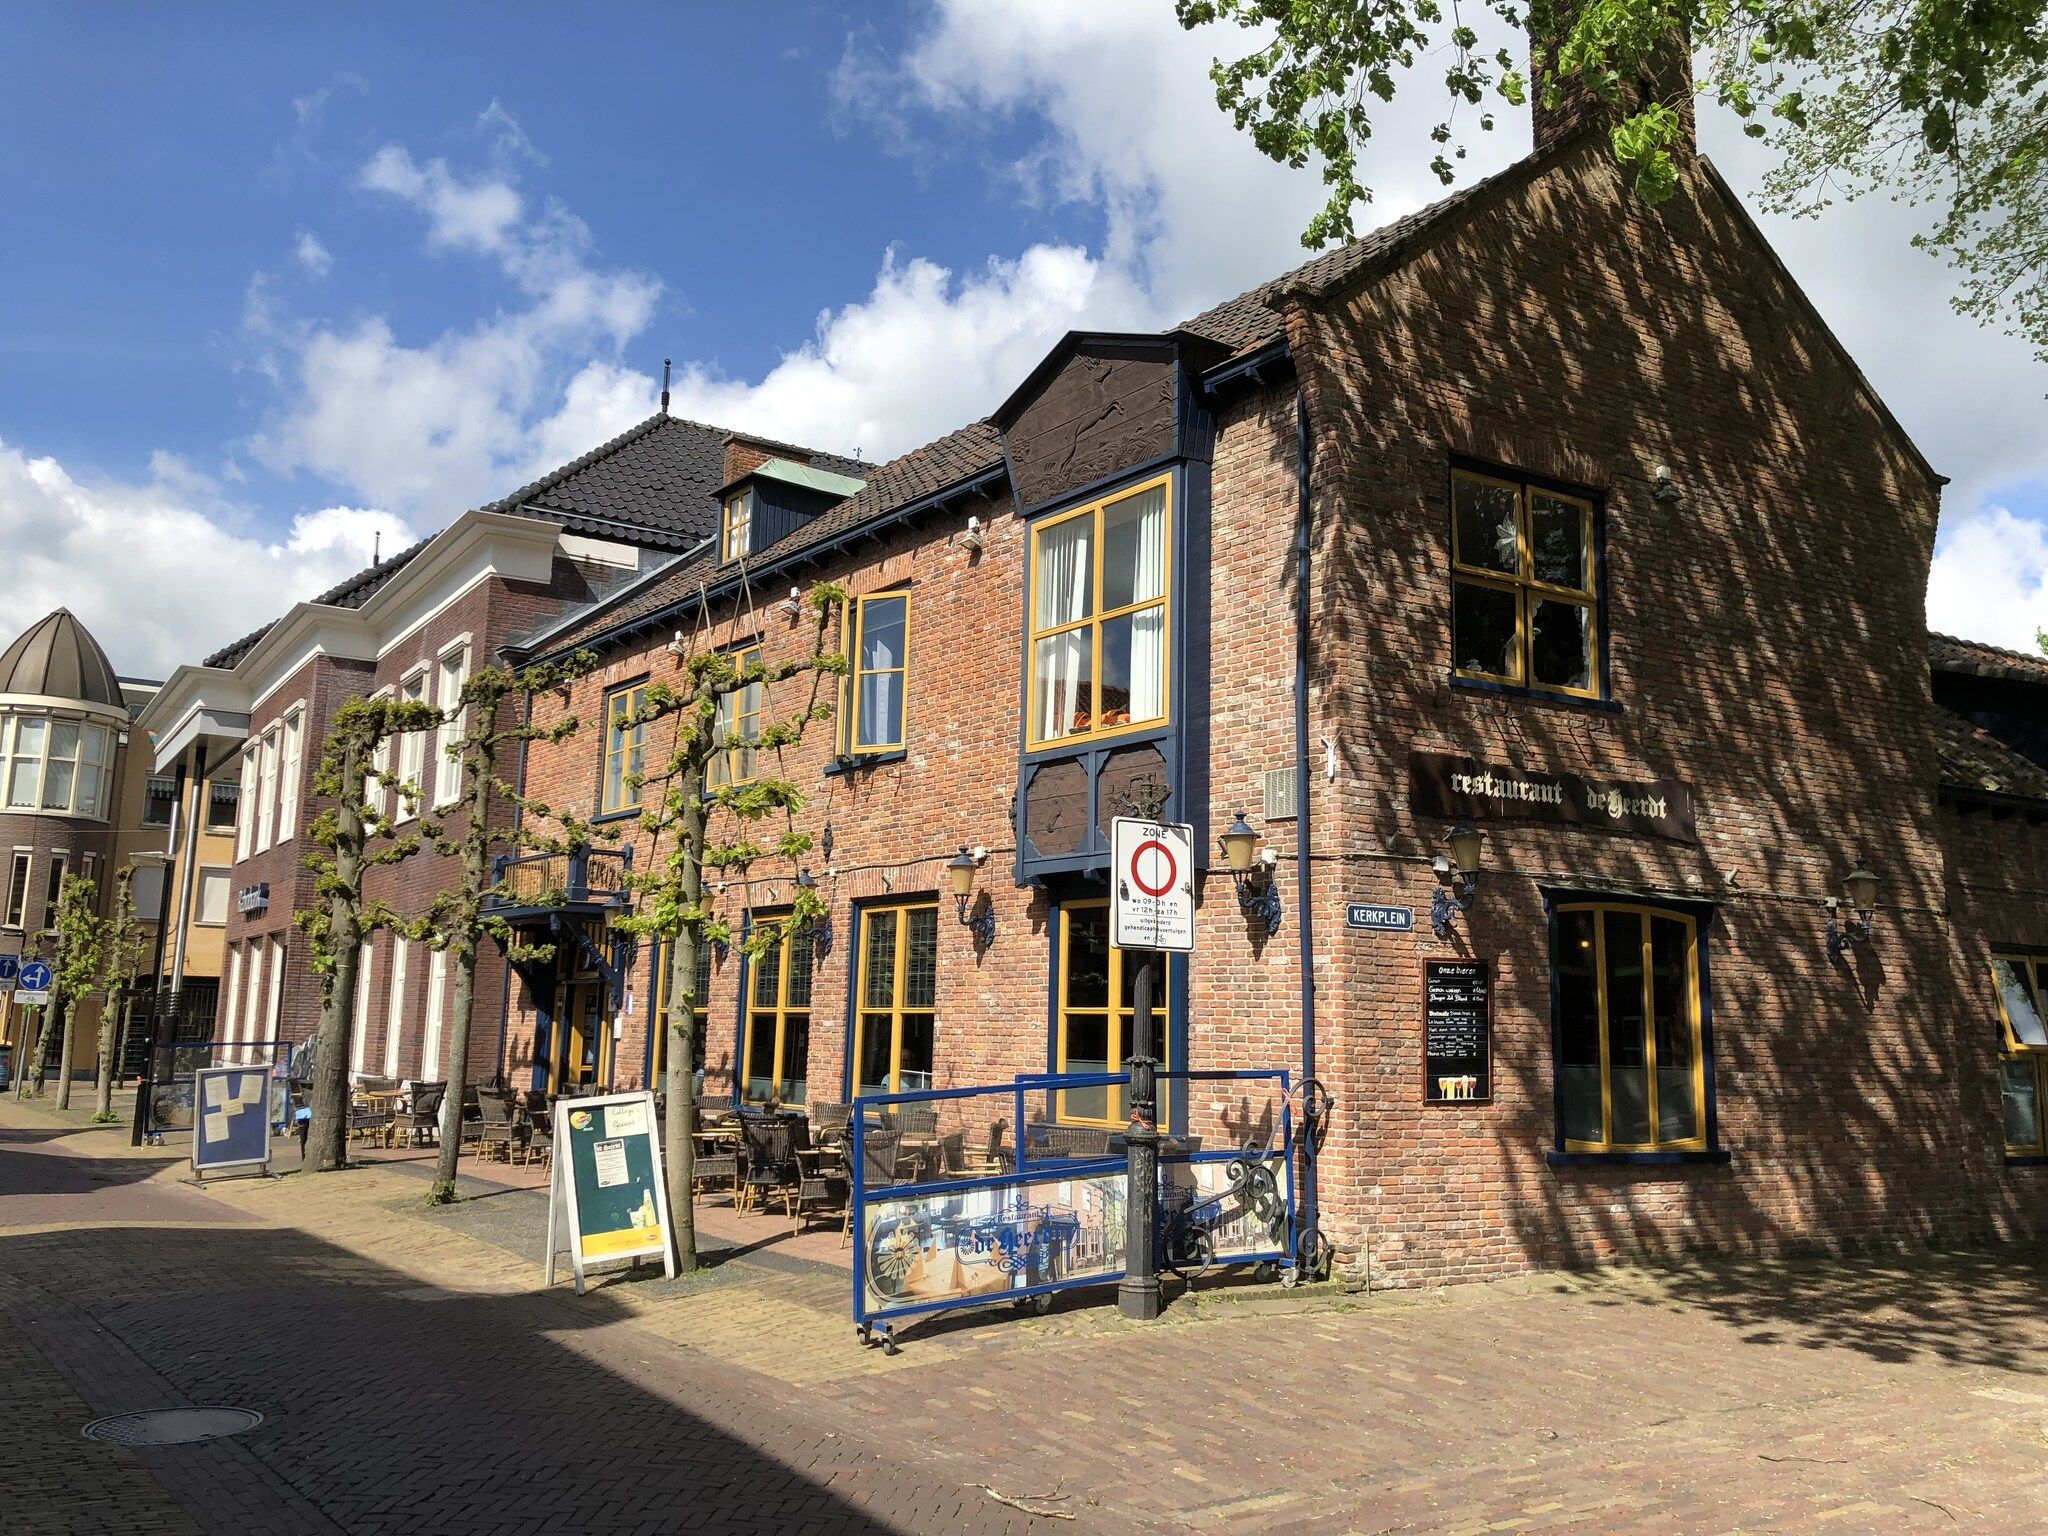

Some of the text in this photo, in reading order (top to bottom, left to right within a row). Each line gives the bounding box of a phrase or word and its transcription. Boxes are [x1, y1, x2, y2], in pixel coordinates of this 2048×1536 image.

[1451, 770, 1563, 805] restaurant
[1142, 827, 1167, 839] ZONE
[1141, 906, 1153, 914] 12h
[1140, 918, 1171, 926] uitgeznderd
[1353, 909, 1405, 925] KERKPLEIN
[997, 1210, 1041, 1222] Restaurant
[974, 1230, 995, 1254] de
